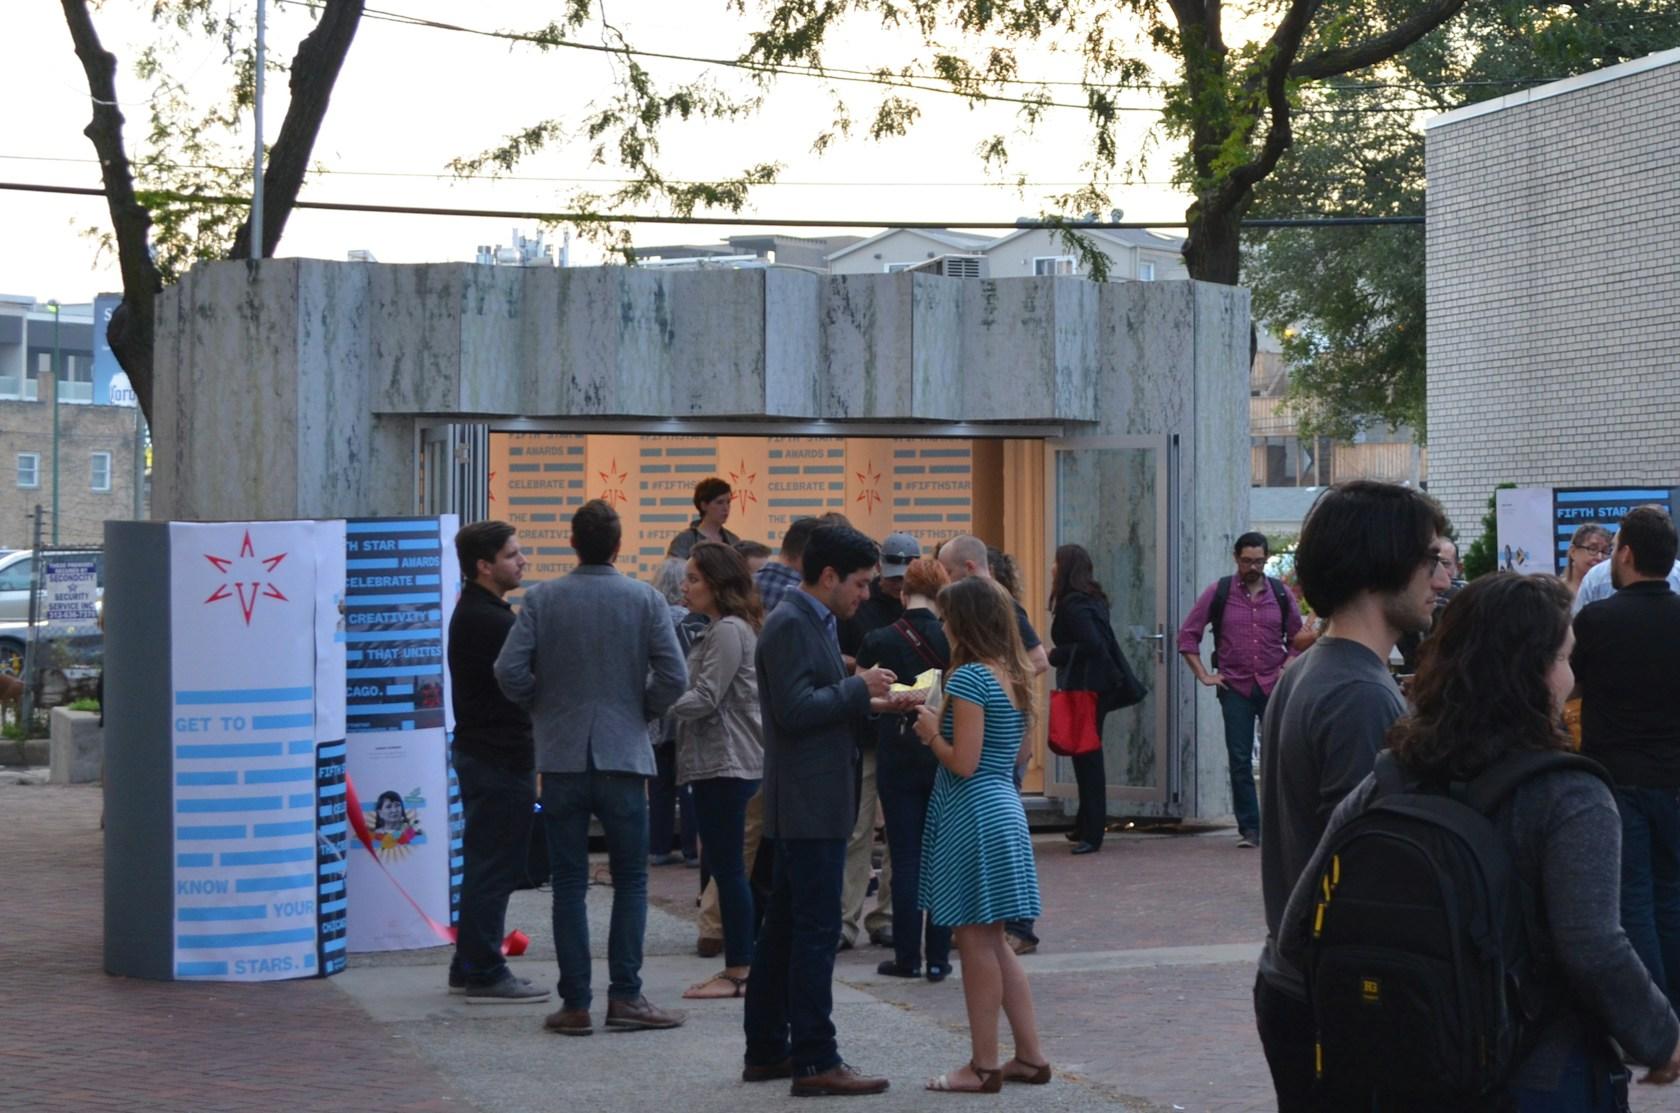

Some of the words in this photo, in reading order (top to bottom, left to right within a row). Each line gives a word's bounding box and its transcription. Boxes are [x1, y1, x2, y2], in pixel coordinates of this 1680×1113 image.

[525, 446, 564, 456] AWARDS
[785, 449, 824, 458] AWARDS
[508, 480, 565, 489] CELEBRATE
[652, 480, 697, 490] #FIFTHS
[768, 482, 825, 491] CELEBRATE
[509, 513, 528, 522] THE
[1557, 508, 1594, 519] FIFTH
[1598, 506, 1627, 518] STAR
[518, 530, 569, 539] CREATIVI
[363, 539, 396, 551] STAR
[401, 556, 440, 568] AWARDS
[55, 592, 89, 601] SECURITY
[49, 602, 79, 610] SERVICE
[349, 611, 427, 625] CREATIVITY
[367, 648, 399, 660] THAT
[403, 646, 442, 658] UNITES
[346, 685, 384, 697] CAGO.
[175, 716, 212, 732] GET
[220, 716, 246, 731] TO
[176, 879, 229, 895] KNOW
[273, 900, 315, 918] YOUR
[234, 956, 300, 974] STARS.
